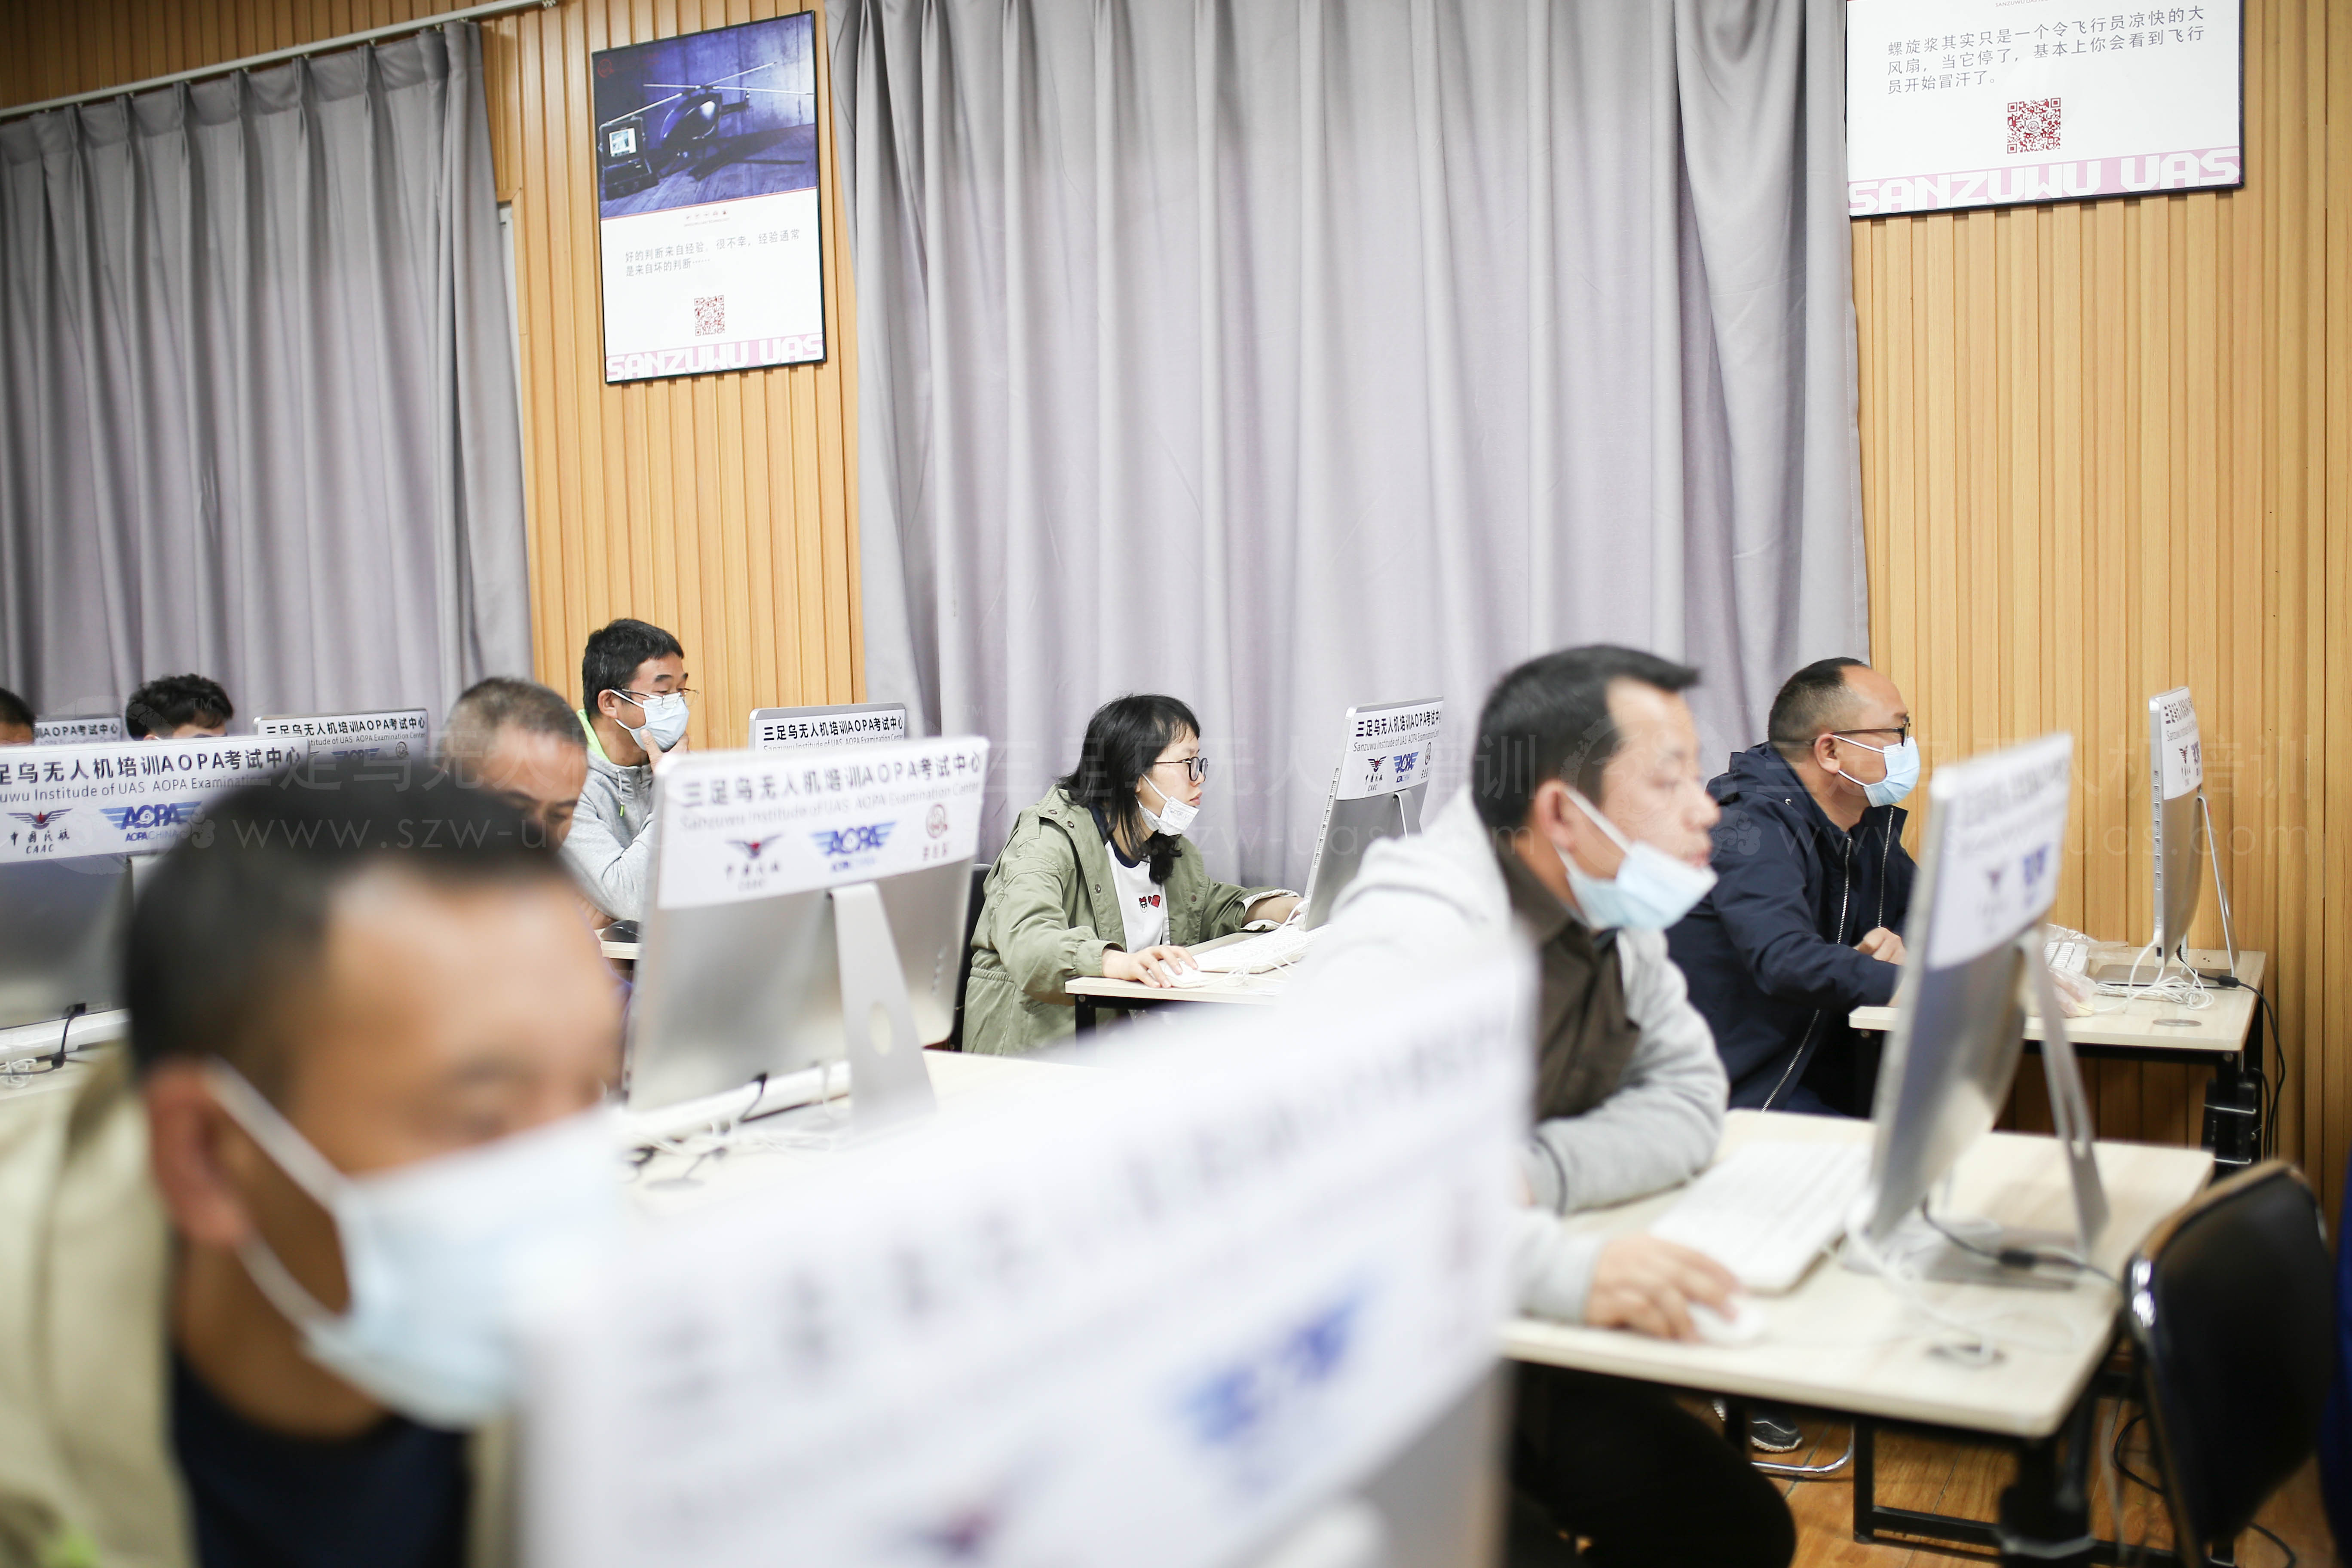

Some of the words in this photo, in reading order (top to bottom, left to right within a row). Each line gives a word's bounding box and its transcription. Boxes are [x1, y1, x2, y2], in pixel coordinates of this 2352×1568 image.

[1888, 25, 2204, 75] 风扇，当它停了，基本上你会看到飞行
[1888, 70, 1995, 94] 员开始冒汗了。
[1849, 160, 2101, 216] SANZUWU
[2121, 149, 2240, 192] UAS
[606, 342, 749, 382] SANZUWU
[759, 334, 823, 365] UAS
[332, 733, 338, 744] of
[340, 733, 352, 744] UAS
[356, 732, 373, 742] AOPA
[374, 730, 409, 741] Examination
[763, 716, 903, 741] 三足乌无人机培训AOPA考试中心
[1353, 742, 1377, 752] Sanzuwu
[35, 785, 97, 801] Institude
[101, 783, 114, 796] of
[119, 781, 145, 794] UAS
[153, 778, 187, 792] AOPA
[681, 752, 980, 808] 三足乌无人机培训AOPA考试中心
[26, 844, 54, 854] CAAC
